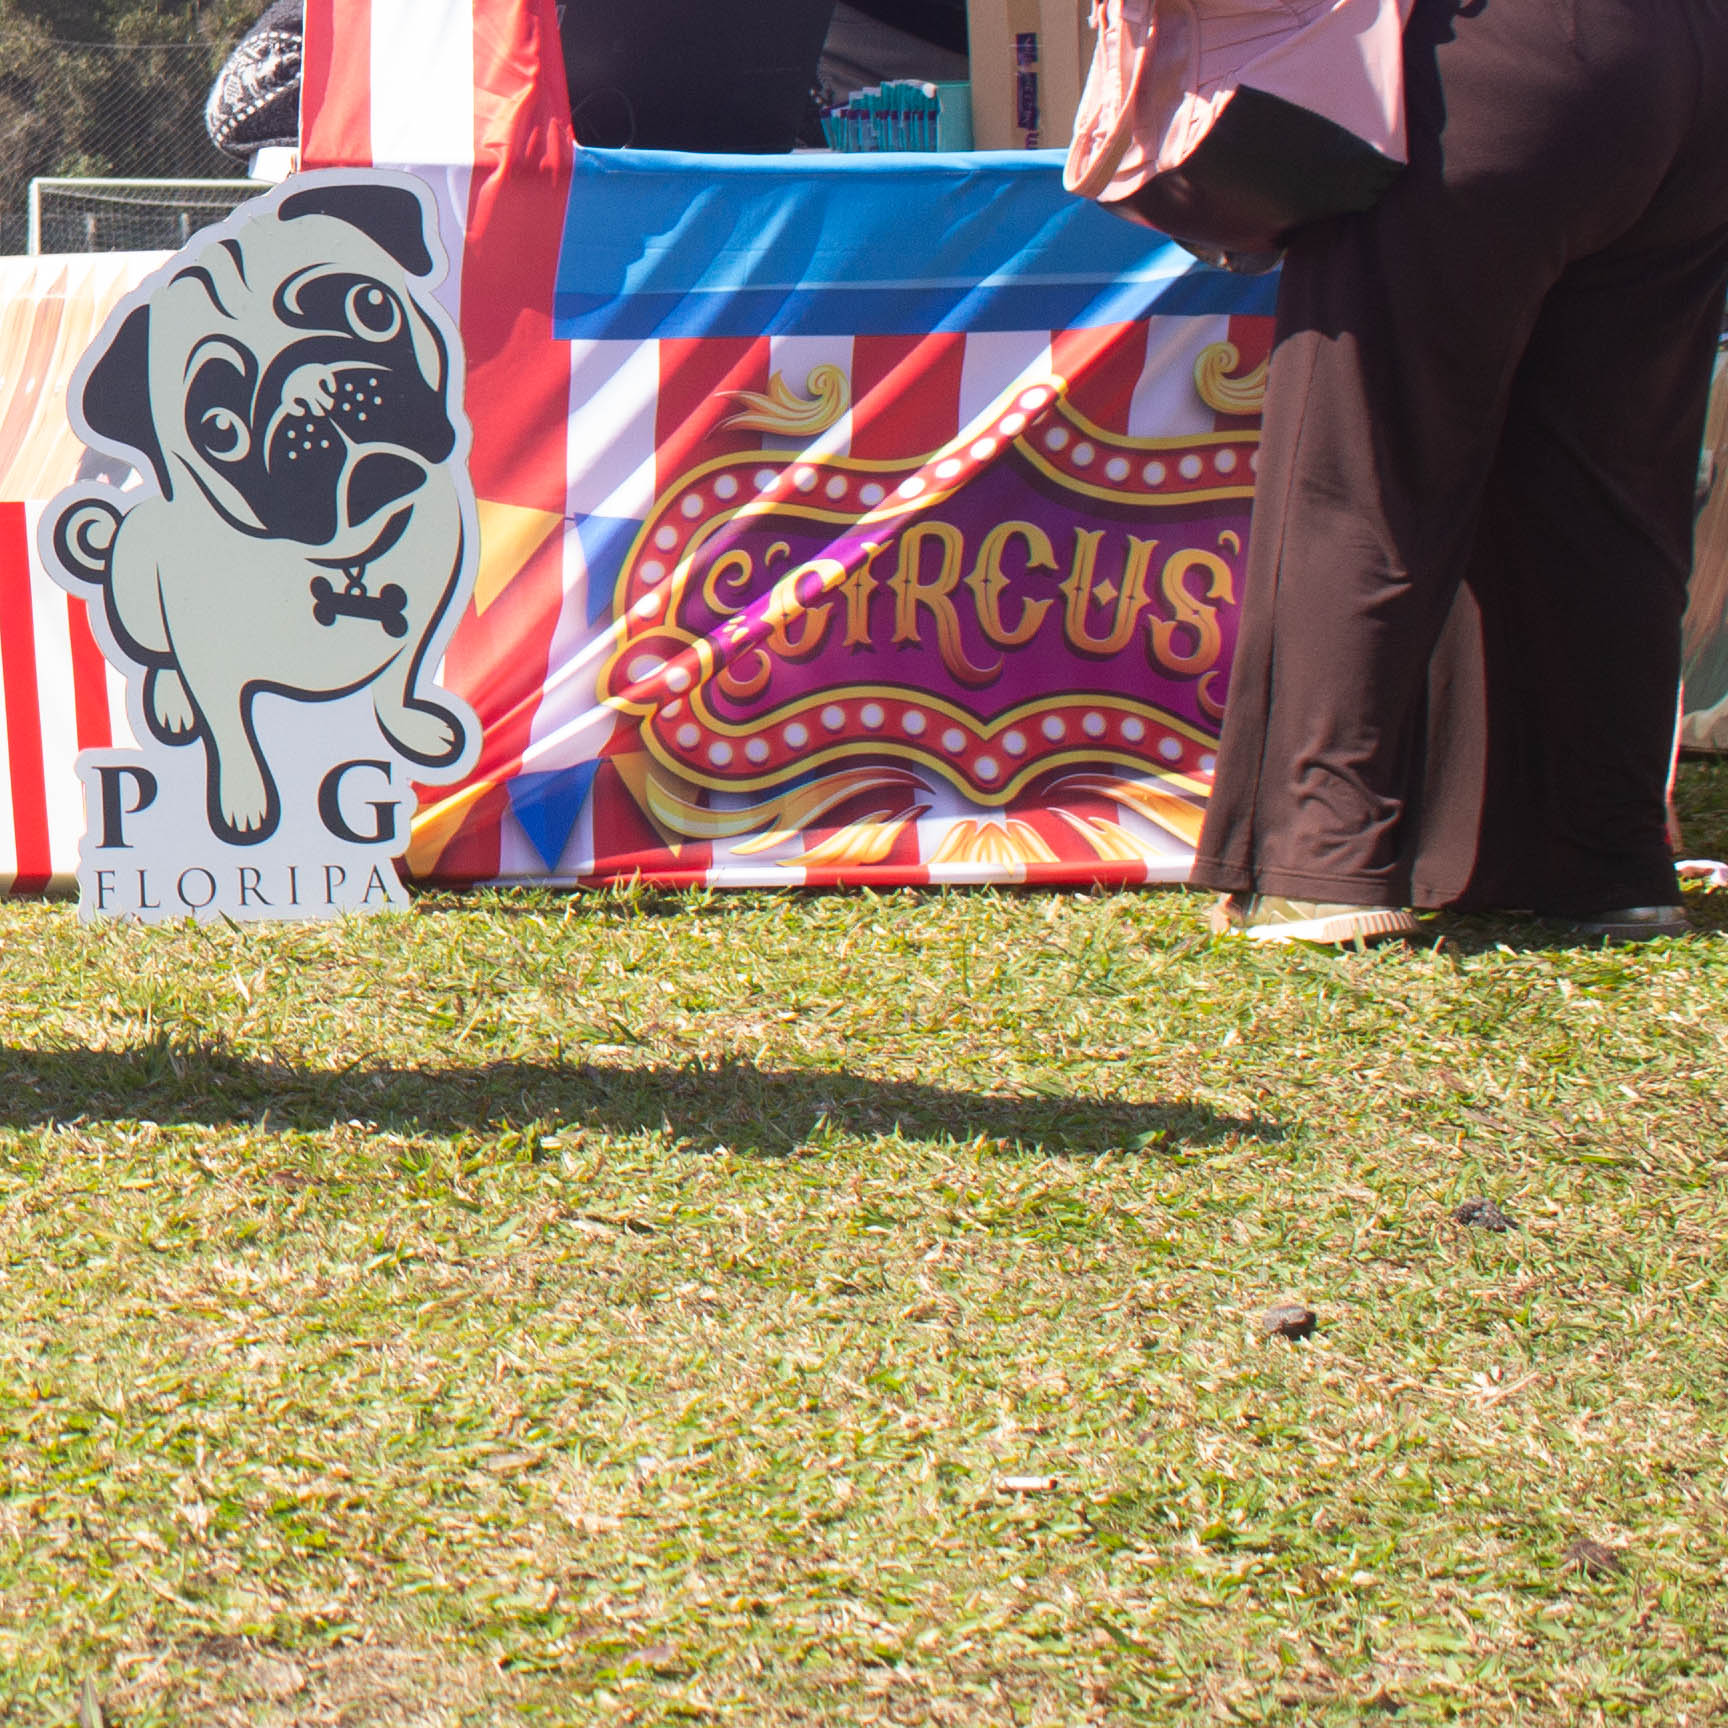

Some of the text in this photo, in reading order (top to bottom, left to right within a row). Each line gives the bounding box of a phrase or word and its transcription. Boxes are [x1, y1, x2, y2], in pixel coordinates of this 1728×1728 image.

[758, 519, 1241, 683] CIRCUS
[91, 759, 403, 849] PUG
[95, 864, 394, 910] FLORIPA
